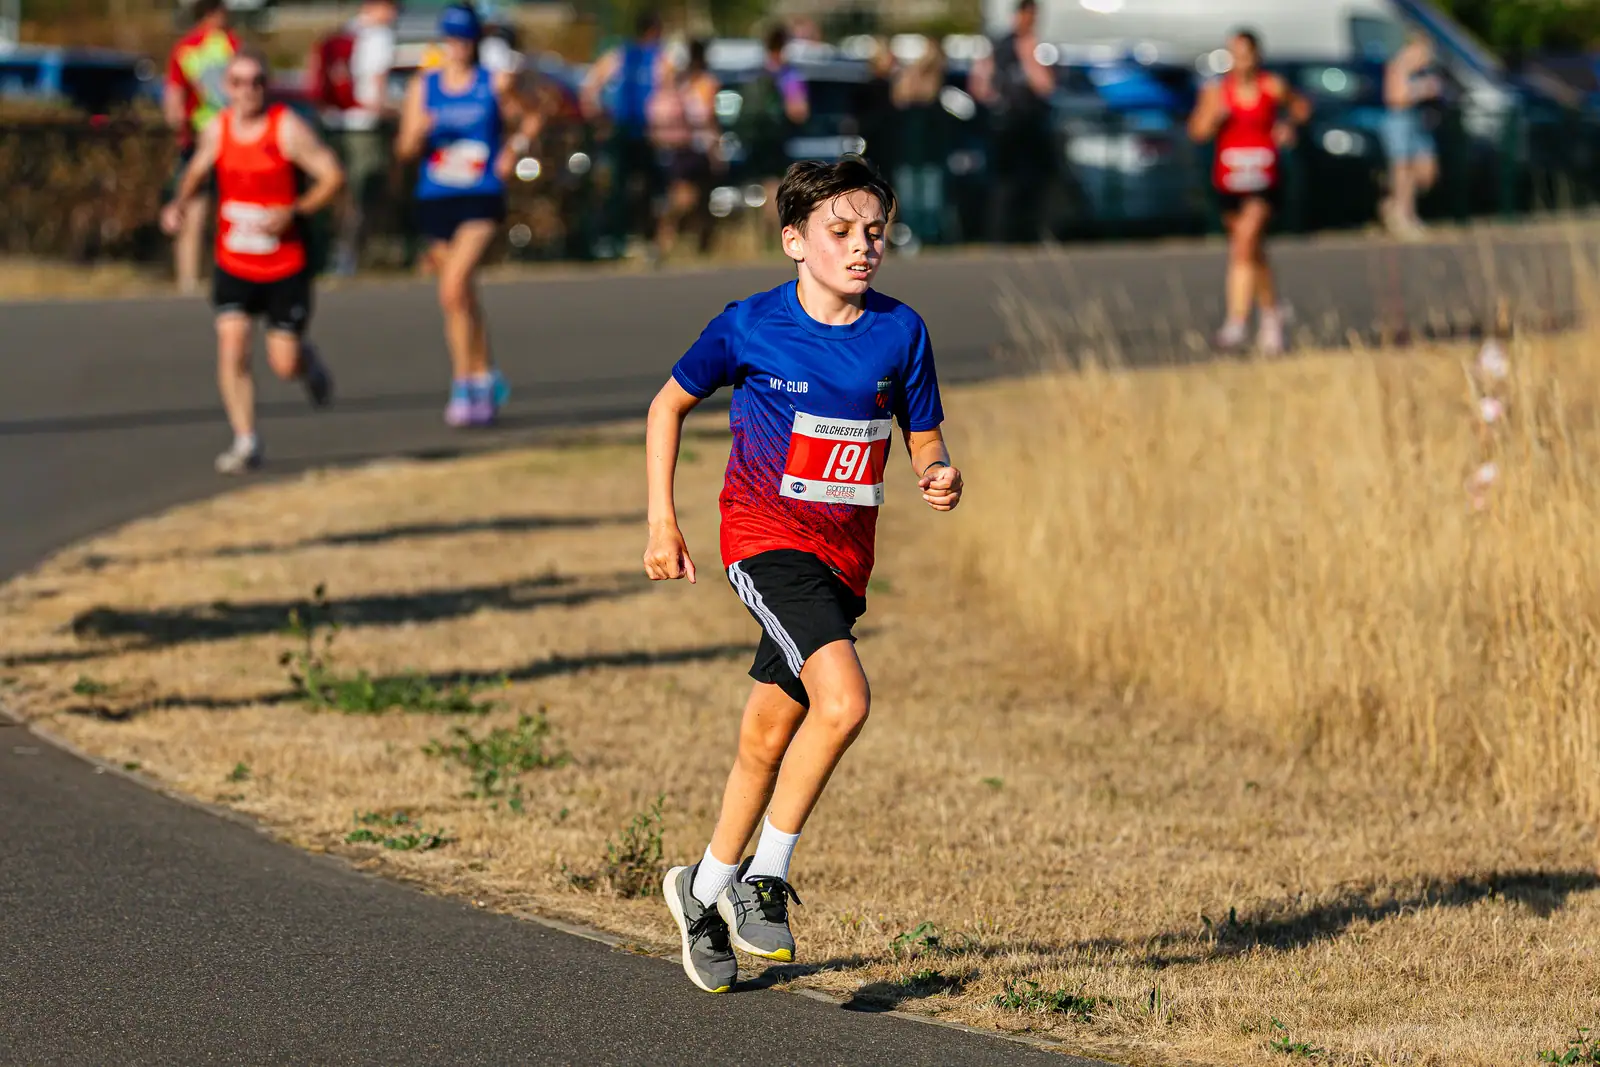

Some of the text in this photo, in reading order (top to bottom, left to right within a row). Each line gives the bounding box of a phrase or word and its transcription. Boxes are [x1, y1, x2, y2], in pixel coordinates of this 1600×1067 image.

[814, 424, 863, 437] COLCHESTER
[822, 443, 871, 481] 191
[826, 485, 856, 493] comms
